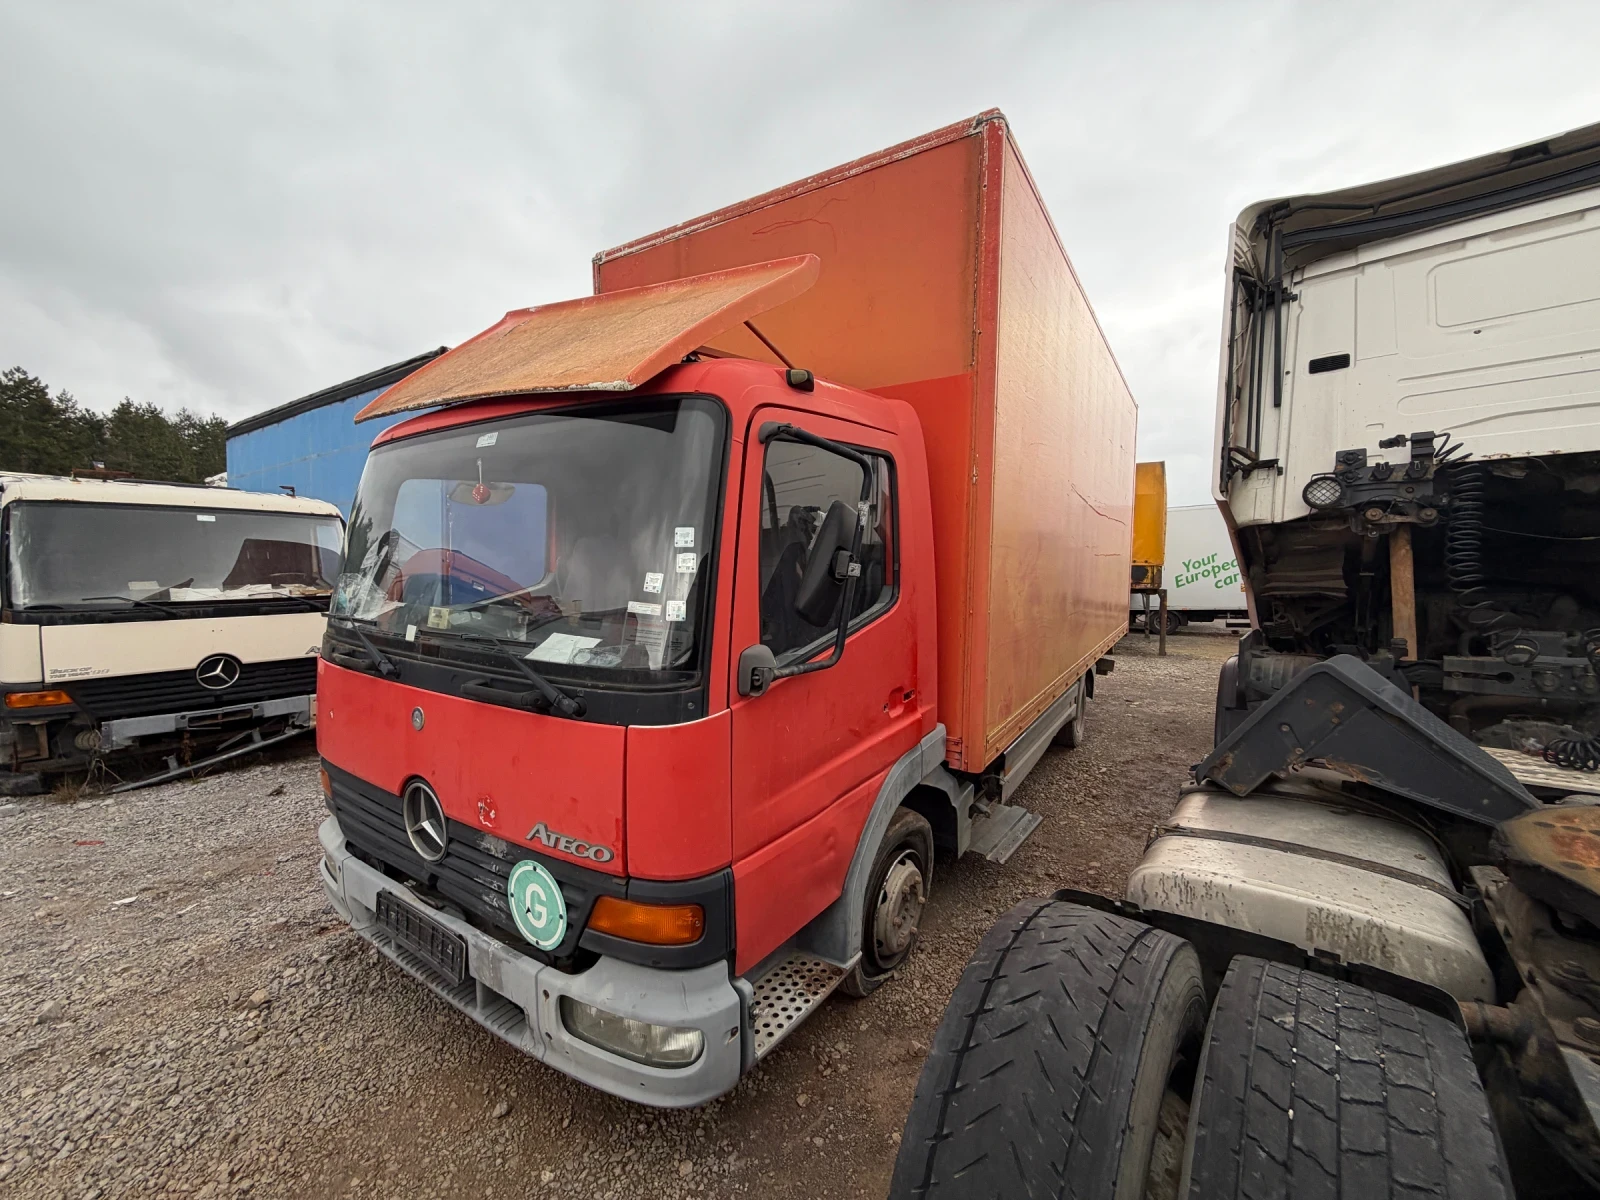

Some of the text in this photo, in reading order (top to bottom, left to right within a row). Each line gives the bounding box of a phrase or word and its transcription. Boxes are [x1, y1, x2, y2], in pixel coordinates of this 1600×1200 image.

[1174, 558, 1239, 589] Europea
[1182, 553, 1218, 573] Your
[525, 882, 548, 929] G
